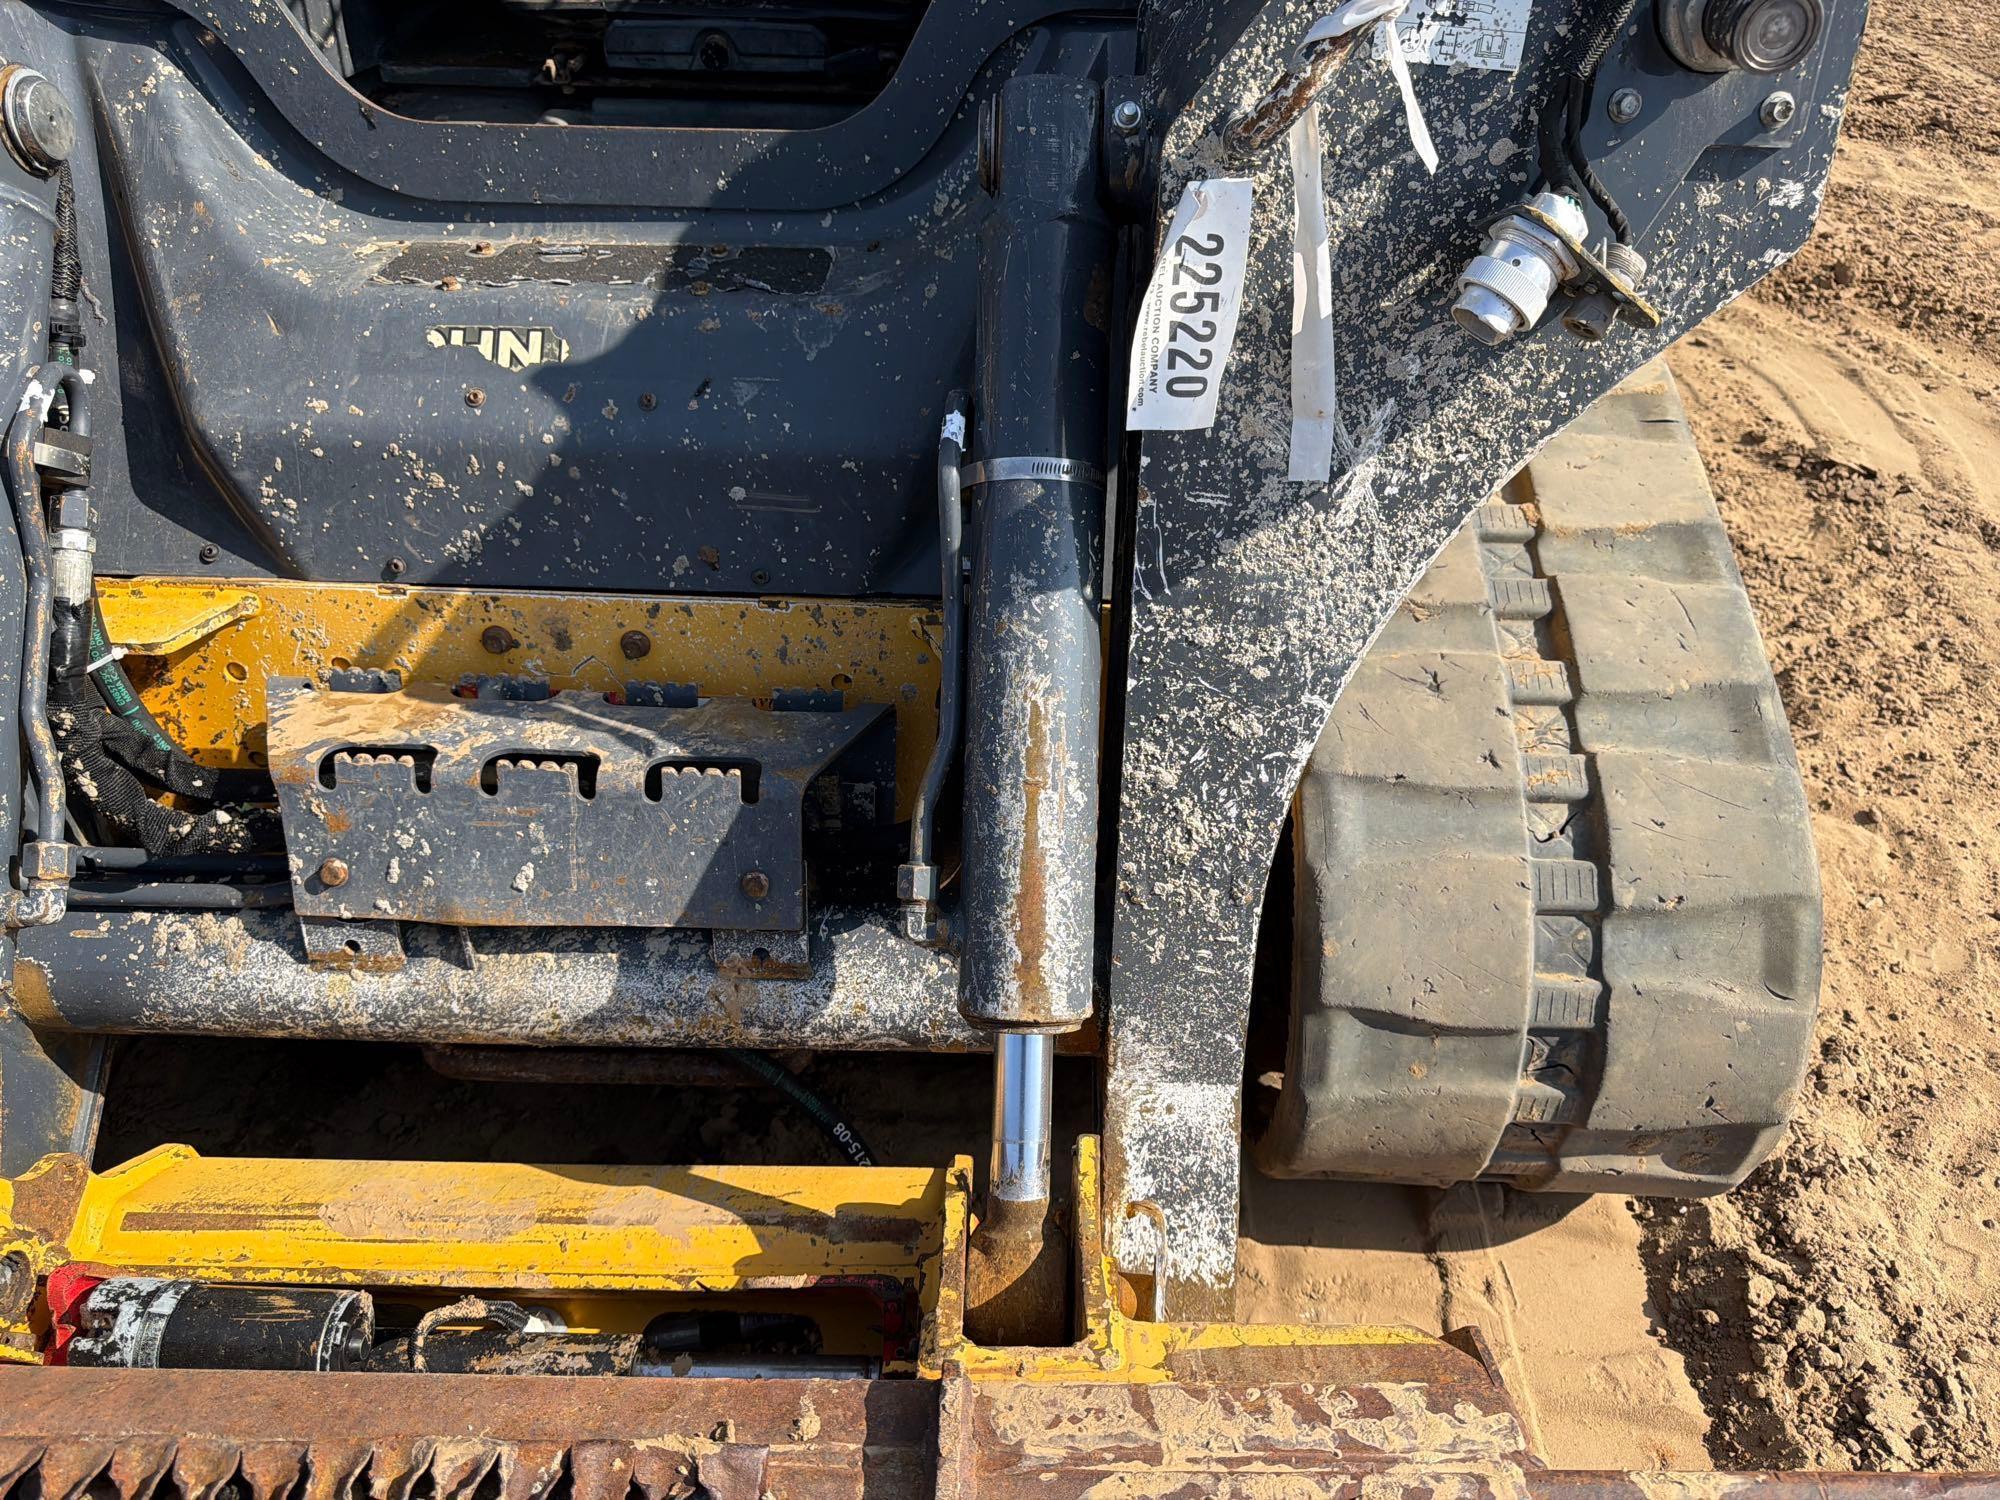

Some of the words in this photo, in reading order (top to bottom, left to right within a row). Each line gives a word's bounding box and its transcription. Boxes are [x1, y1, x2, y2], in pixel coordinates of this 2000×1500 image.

[1152, 283, 1164, 334] AUCTION
[1165, 233, 1225, 399] 225220
[1149, 337, 1160, 394] COMPANY
[115, 680, 133, 703] MSHA
